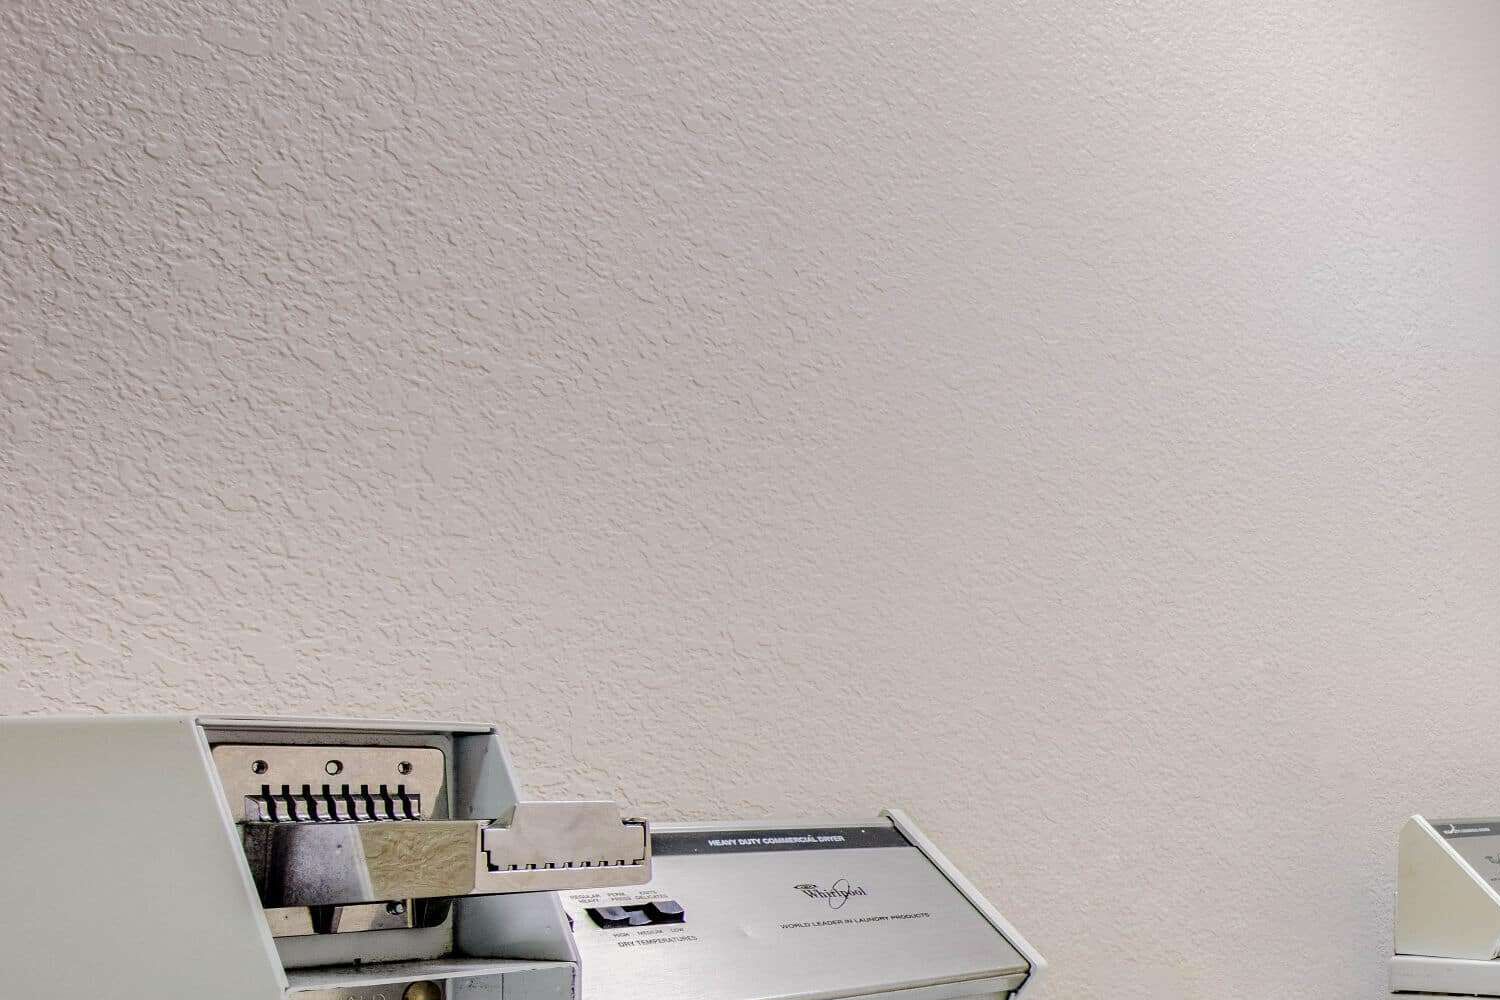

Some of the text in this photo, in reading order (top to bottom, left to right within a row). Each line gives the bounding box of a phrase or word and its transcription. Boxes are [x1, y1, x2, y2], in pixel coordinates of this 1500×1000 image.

[708, 834, 846, 847] HEAVY DUTY COMMERCIAL DRYER
[799, 878, 868, 910] Whirlpool
[780, 911, 931, 930] WORLD LEADER IN LAUNDRY PRODUCTS
[618, 935, 698, 948] DRY TEMPERATURES
